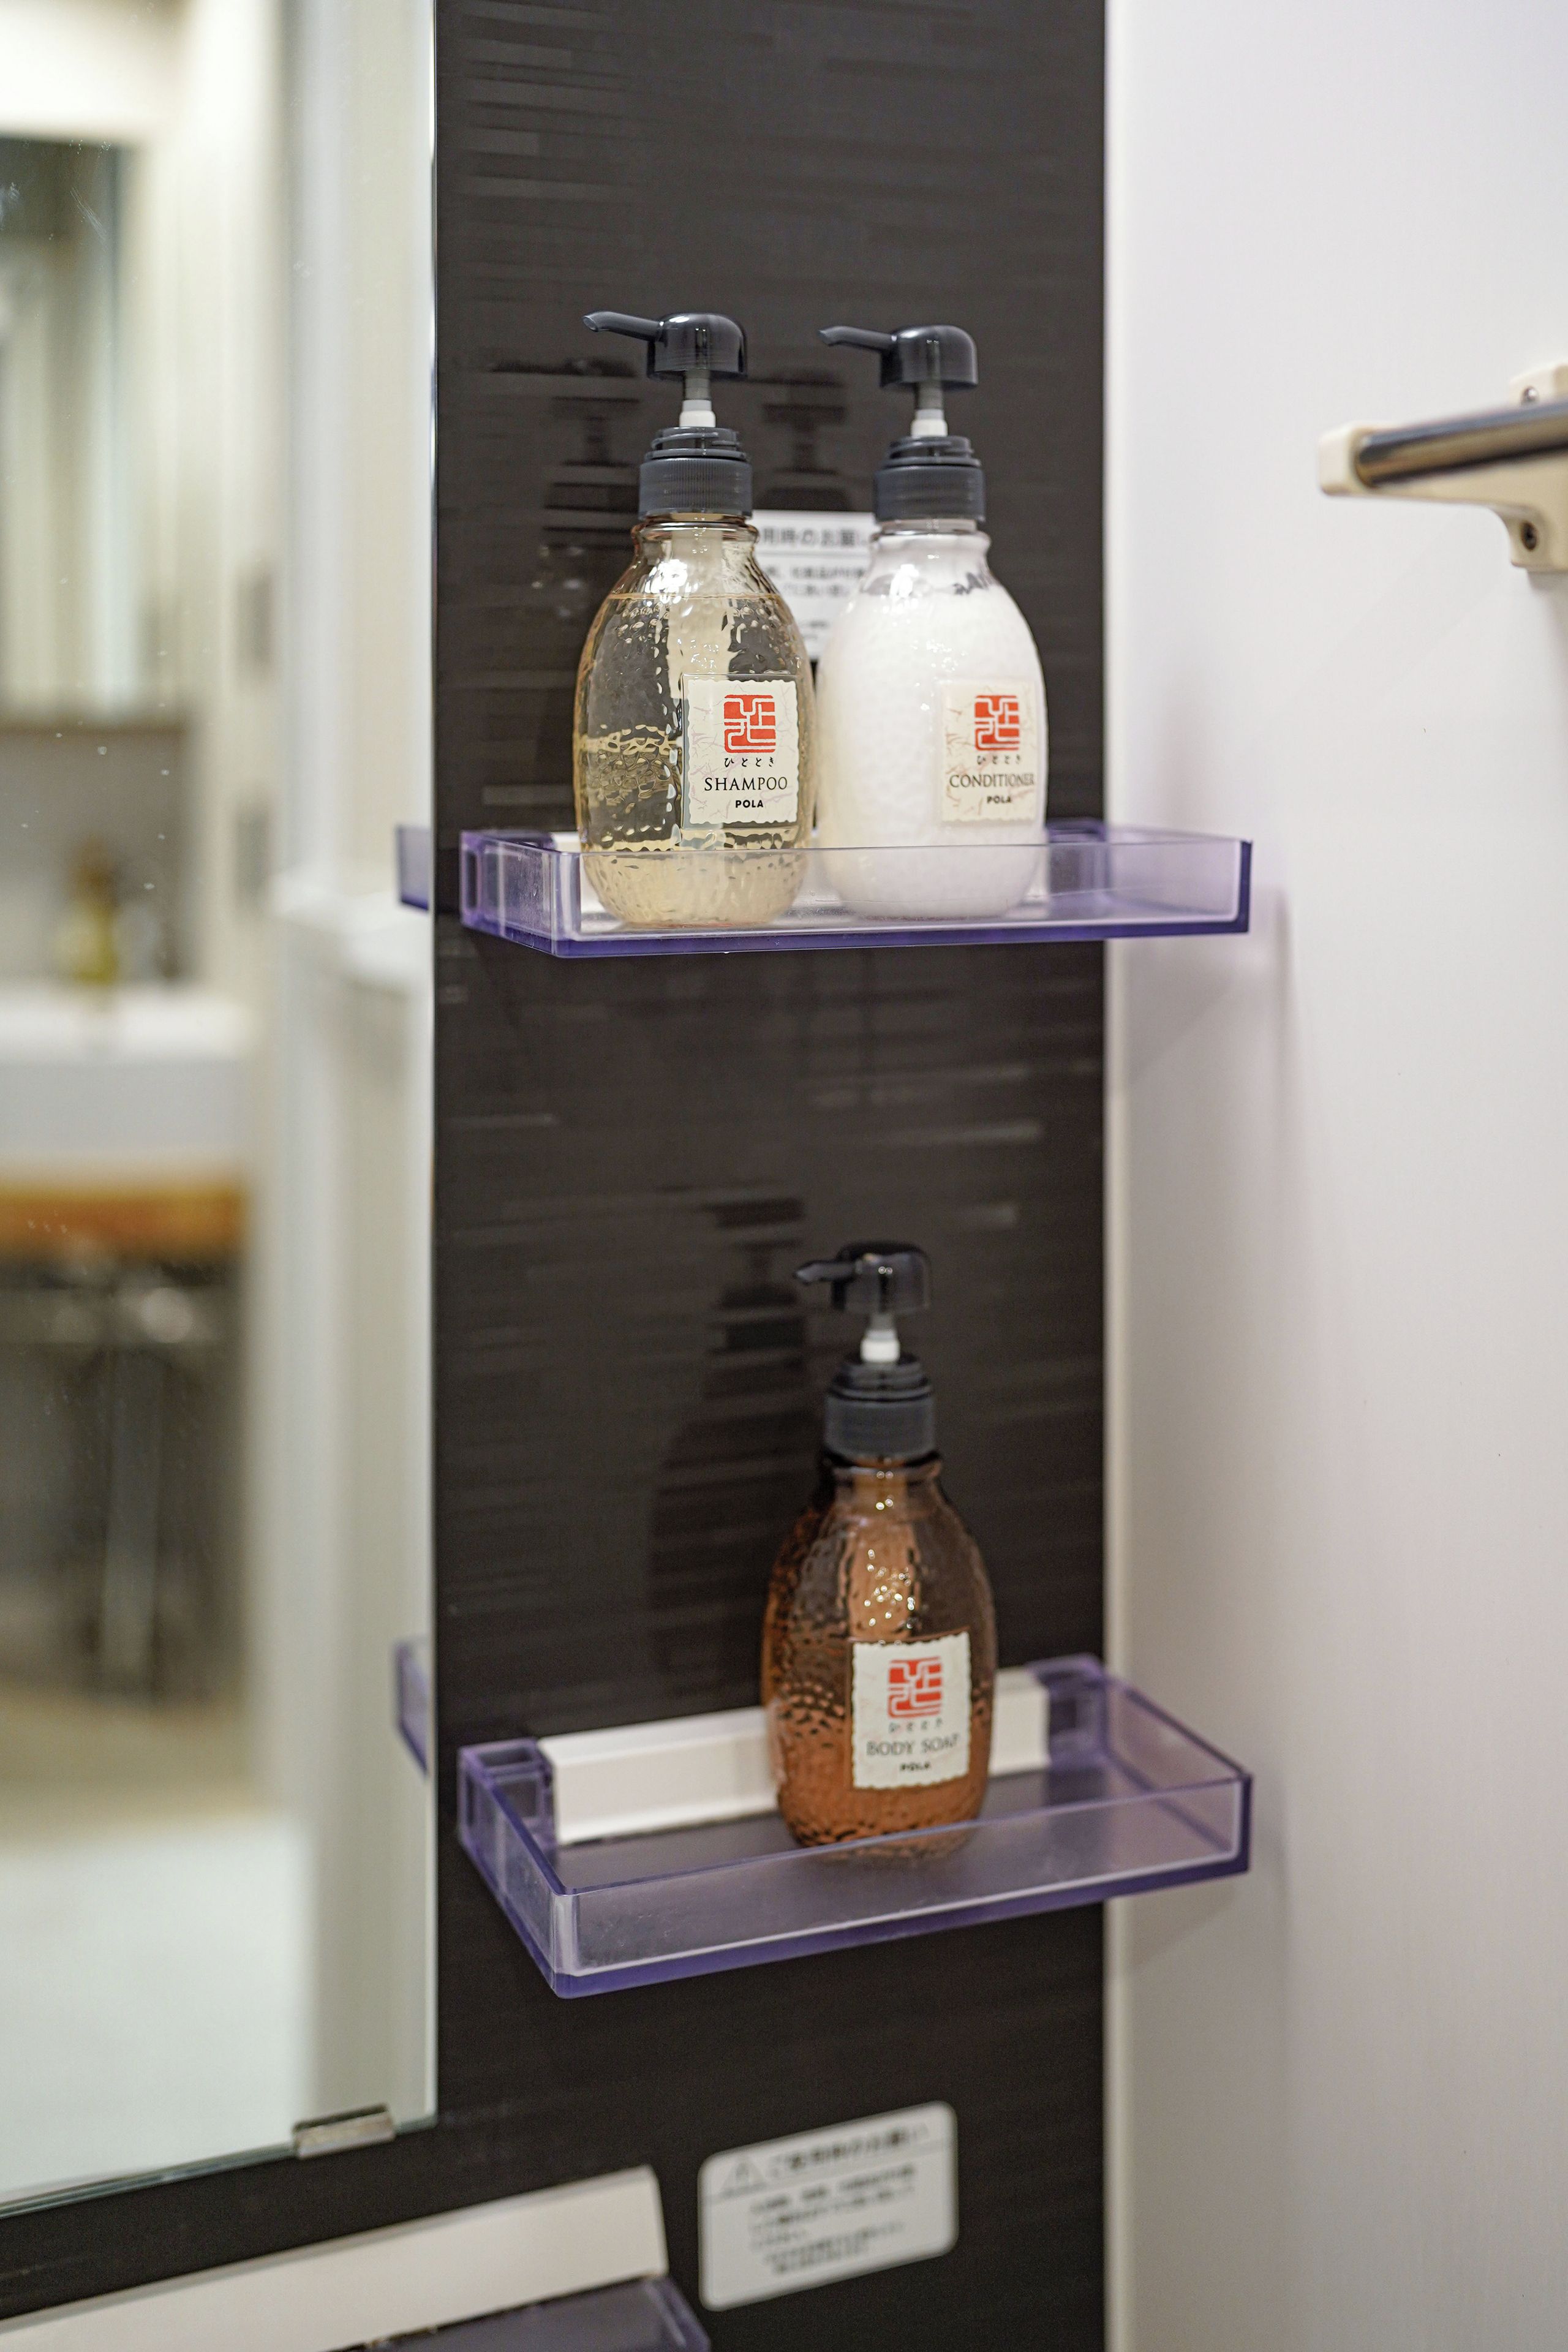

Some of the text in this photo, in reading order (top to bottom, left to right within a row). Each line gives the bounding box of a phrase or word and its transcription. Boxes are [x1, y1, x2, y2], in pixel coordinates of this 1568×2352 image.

[724, 756, 774, 767] ひととき
[704, 776, 788, 791] SHAMPOO
[949, 774, 1035, 788] CONDITIONER
[735, 799, 764, 808] POLA
[987, 795, 1012, 804] POLA
[866, 1733, 960, 1756] BODY SOAP
